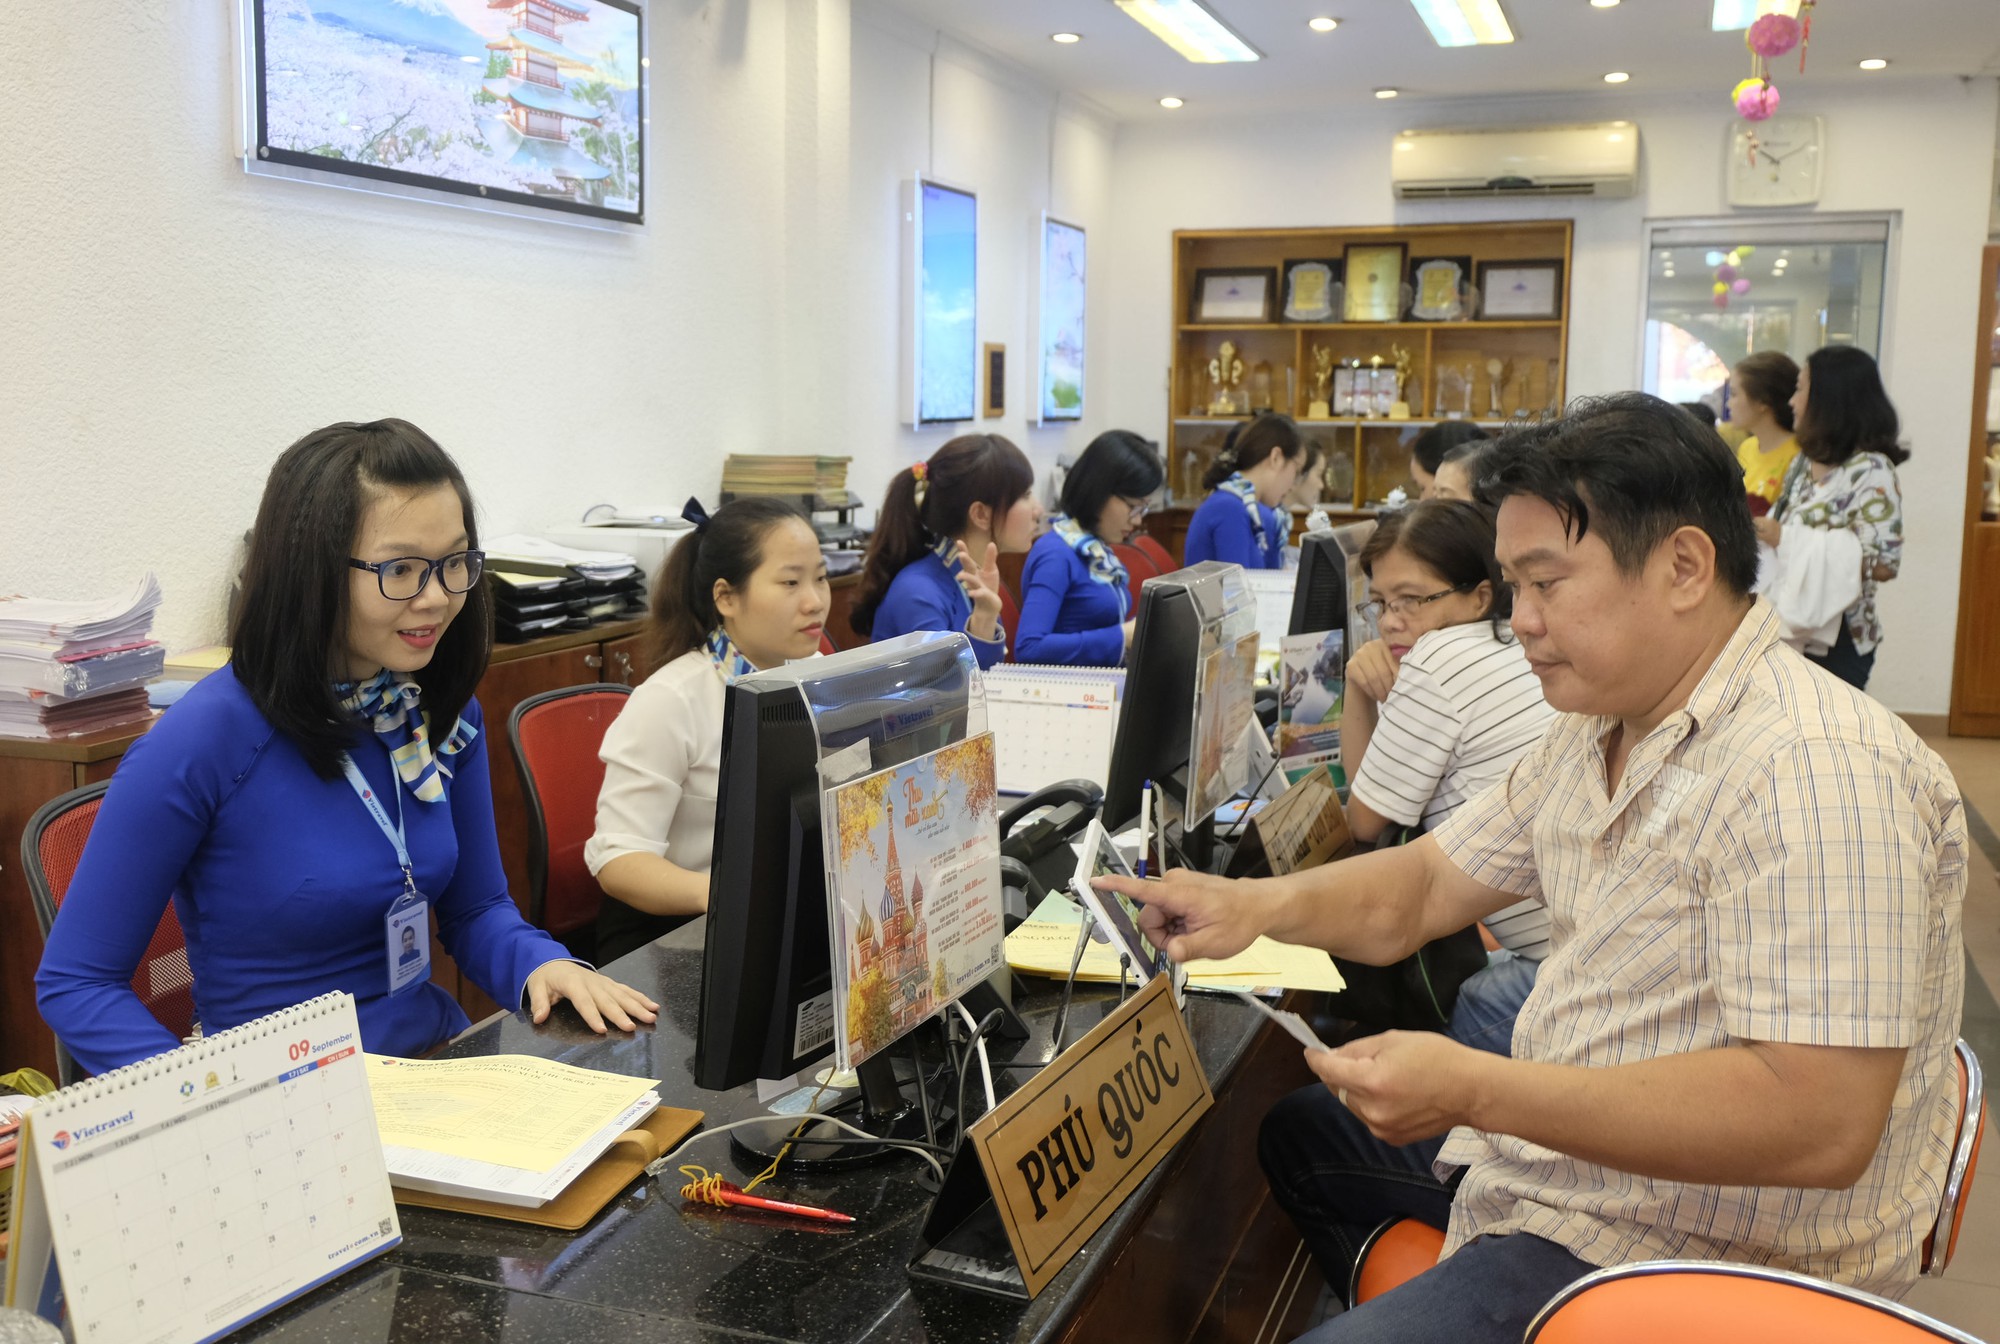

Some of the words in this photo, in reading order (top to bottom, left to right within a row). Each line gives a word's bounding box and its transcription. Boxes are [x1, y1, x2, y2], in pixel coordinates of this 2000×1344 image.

[898, 705, 934, 726] Vietravel
[288, 1039, 310, 1061] 09
[312, 1032, 353, 1054] September
[72, 1110, 134, 1142] Vietravel
[1016, 1093, 1096, 1223] PHÚ
[1097, 1018, 1180, 1160] QUỐC
